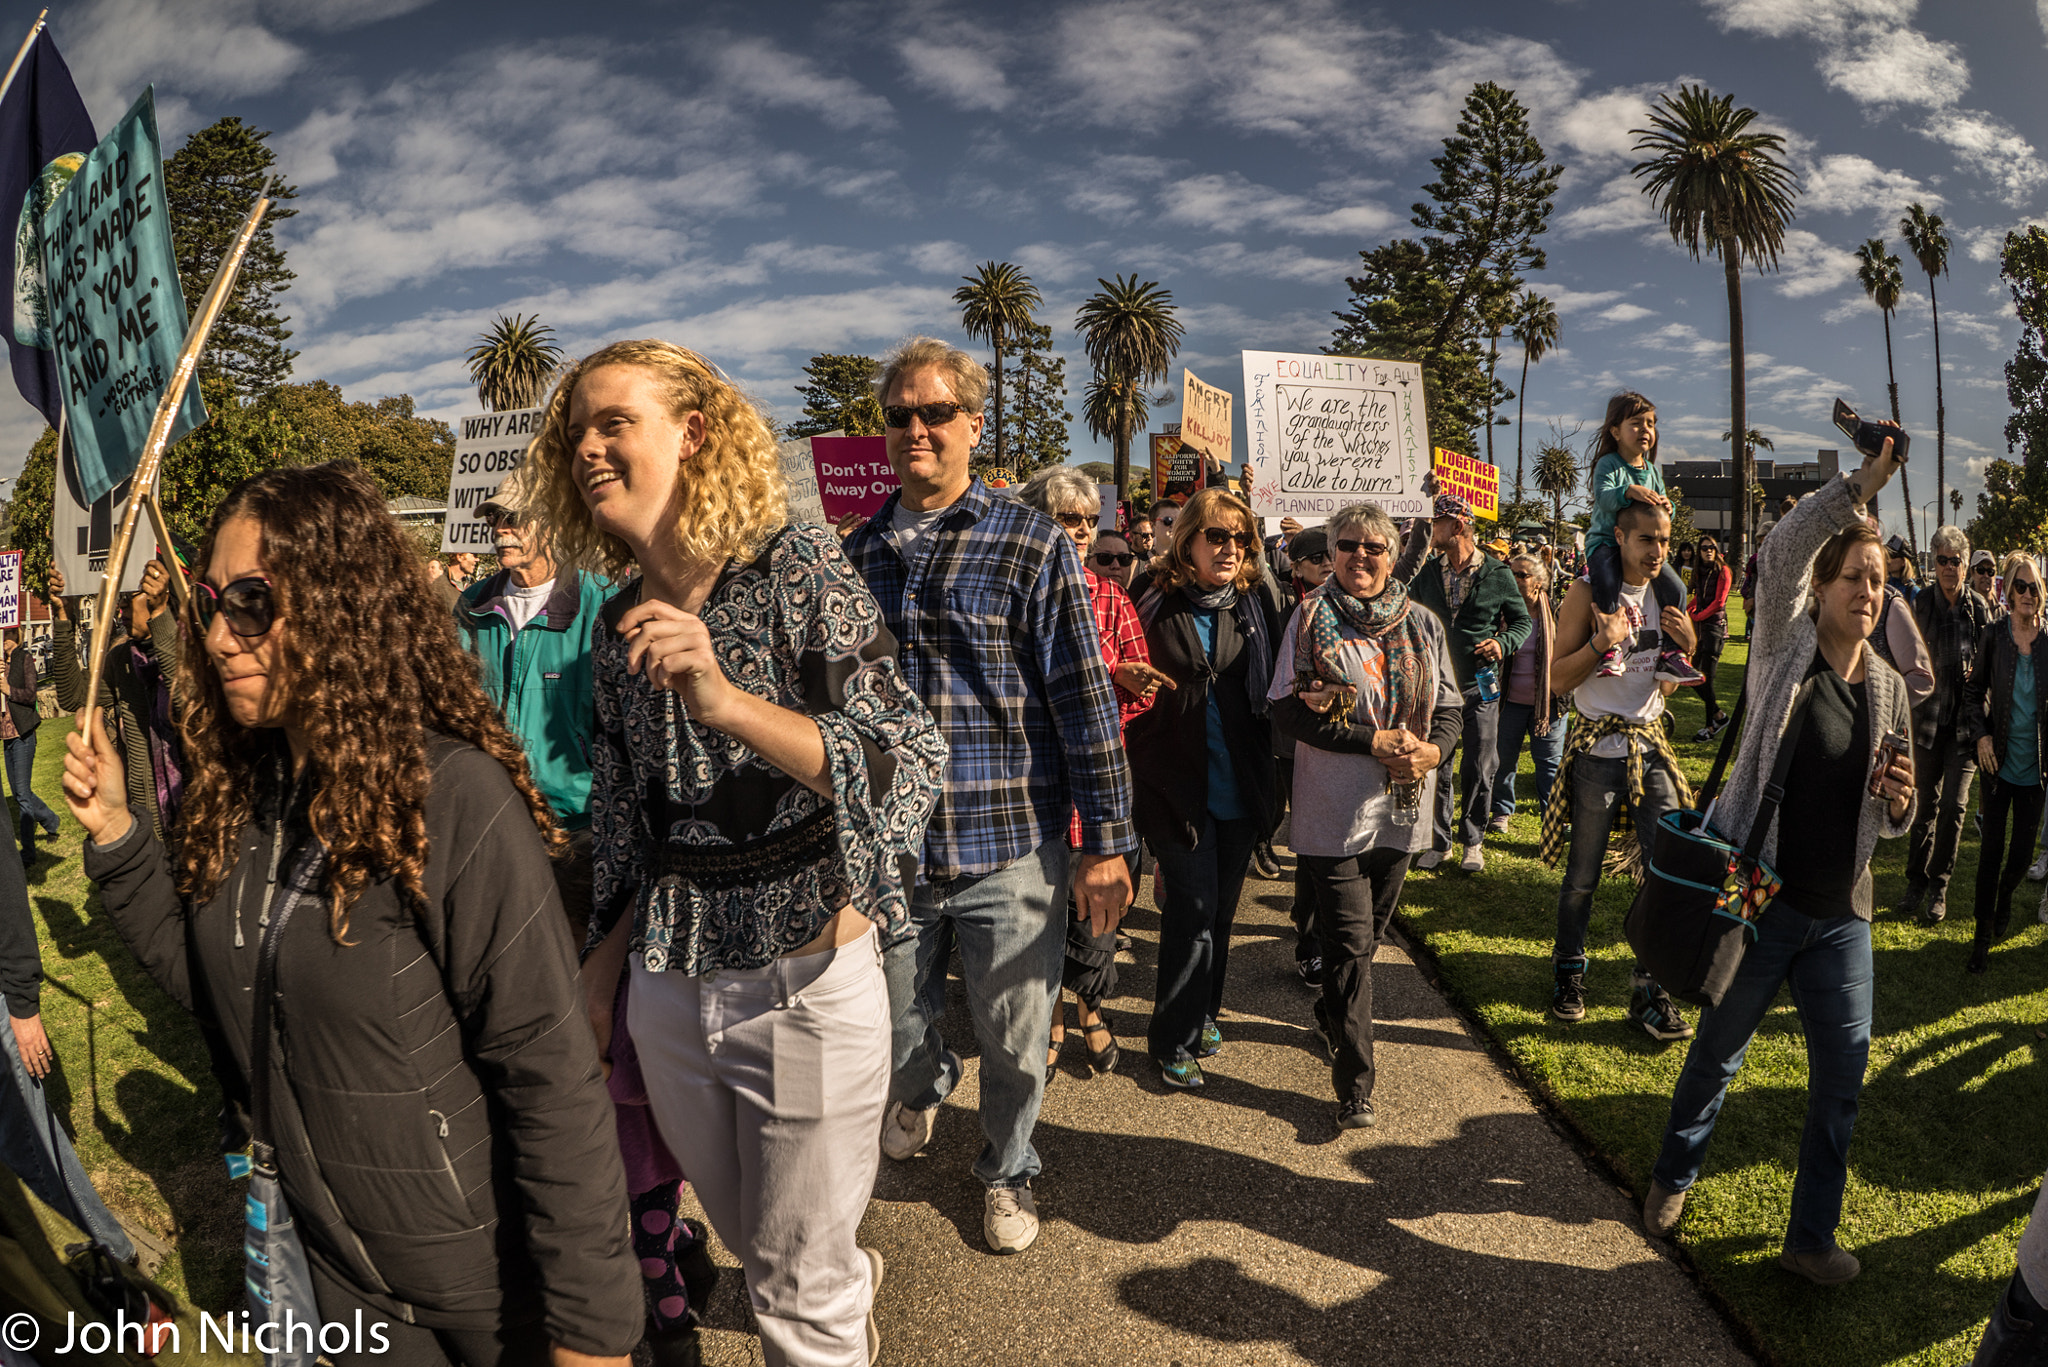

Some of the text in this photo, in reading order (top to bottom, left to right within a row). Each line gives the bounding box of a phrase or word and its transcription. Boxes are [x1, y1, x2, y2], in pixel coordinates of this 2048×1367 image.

[44, 150, 128, 264] THIS LAND
[52, 173, 151, 310] WAS MADE
[55, 297, 91, 366] FOR
[69, 292, 158, 406] AND ME
[1277, 360, 1368, 382] EQUALITY
[1188, 378, 1230, 408] ANGRY
[1320, 398, 1351, 415] are
[1358, 390, 1387, 418] the
[465, 416, 504, 440] WHY
[1292, 429, 1310, 450] of
[1313, 428, 1334, 449] the
[458, 453, 480, 474] SO
[821, 462, 866, 477] Don't
[1282, 449, 1309, 472] you
[1441, 449, 1495, 479] TOGETHER
[1288, 462, 1327, 490] able
[1331, 467, 1348, 490] to
[1436, 464, 1498, 494] WE CAN MAKE
[455, 487, 497, 508] WITH
[825, 482, 867, 499] Away
[1251, 480, 1282, 509] SAVE
[1440, 480, 1494, 511] CHANGE!
[1275, 498, 1335, 513] PLANNED
[4, 585, 10, 593] A
[1632, 656, 1651, 664] GOOD
